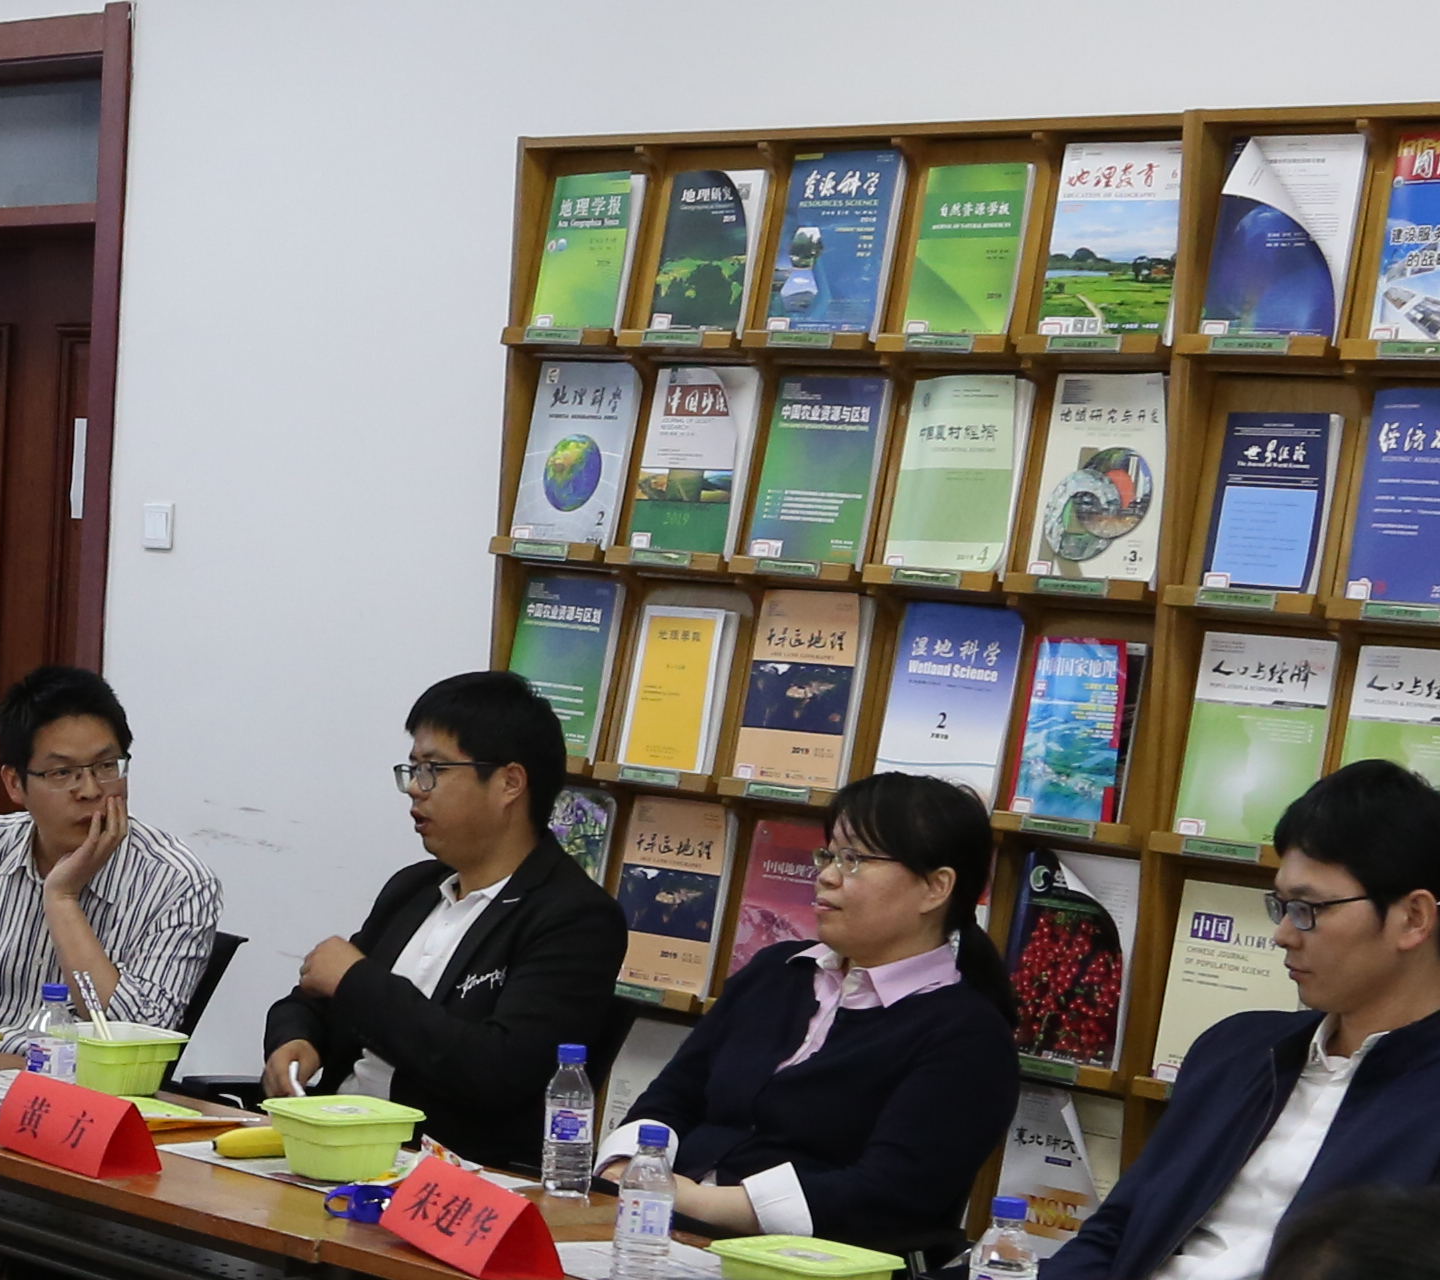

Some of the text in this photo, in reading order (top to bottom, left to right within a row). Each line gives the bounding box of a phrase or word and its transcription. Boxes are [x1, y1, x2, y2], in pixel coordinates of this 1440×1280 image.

[681, 187, 734, 203] 地理研究
[559, 195, 621, 218] 地理学报
[939, 200, 1011, 218] 自然资源学报
[780, 404, 870, 424] 中国农业资源与区划
[595, 510, 606, 527] 2
[977, 546, 989, 565] 4
[526, 601, 602, 625] 中国农业资源与区划
[911, 636, 1001, 667] 湿地科学
[908, 659, 999, 683] Wetland Science
[936, 711, 948, 730] 2
[1186, 945, 1250, 962] CHINESE JOURNAL
[1184, 956, 1272, 977] OF POPULATION SCIENCE
[15, 1094, 95, 1151] 黄方
[402, 1180, 499, 1248] 朱建华
